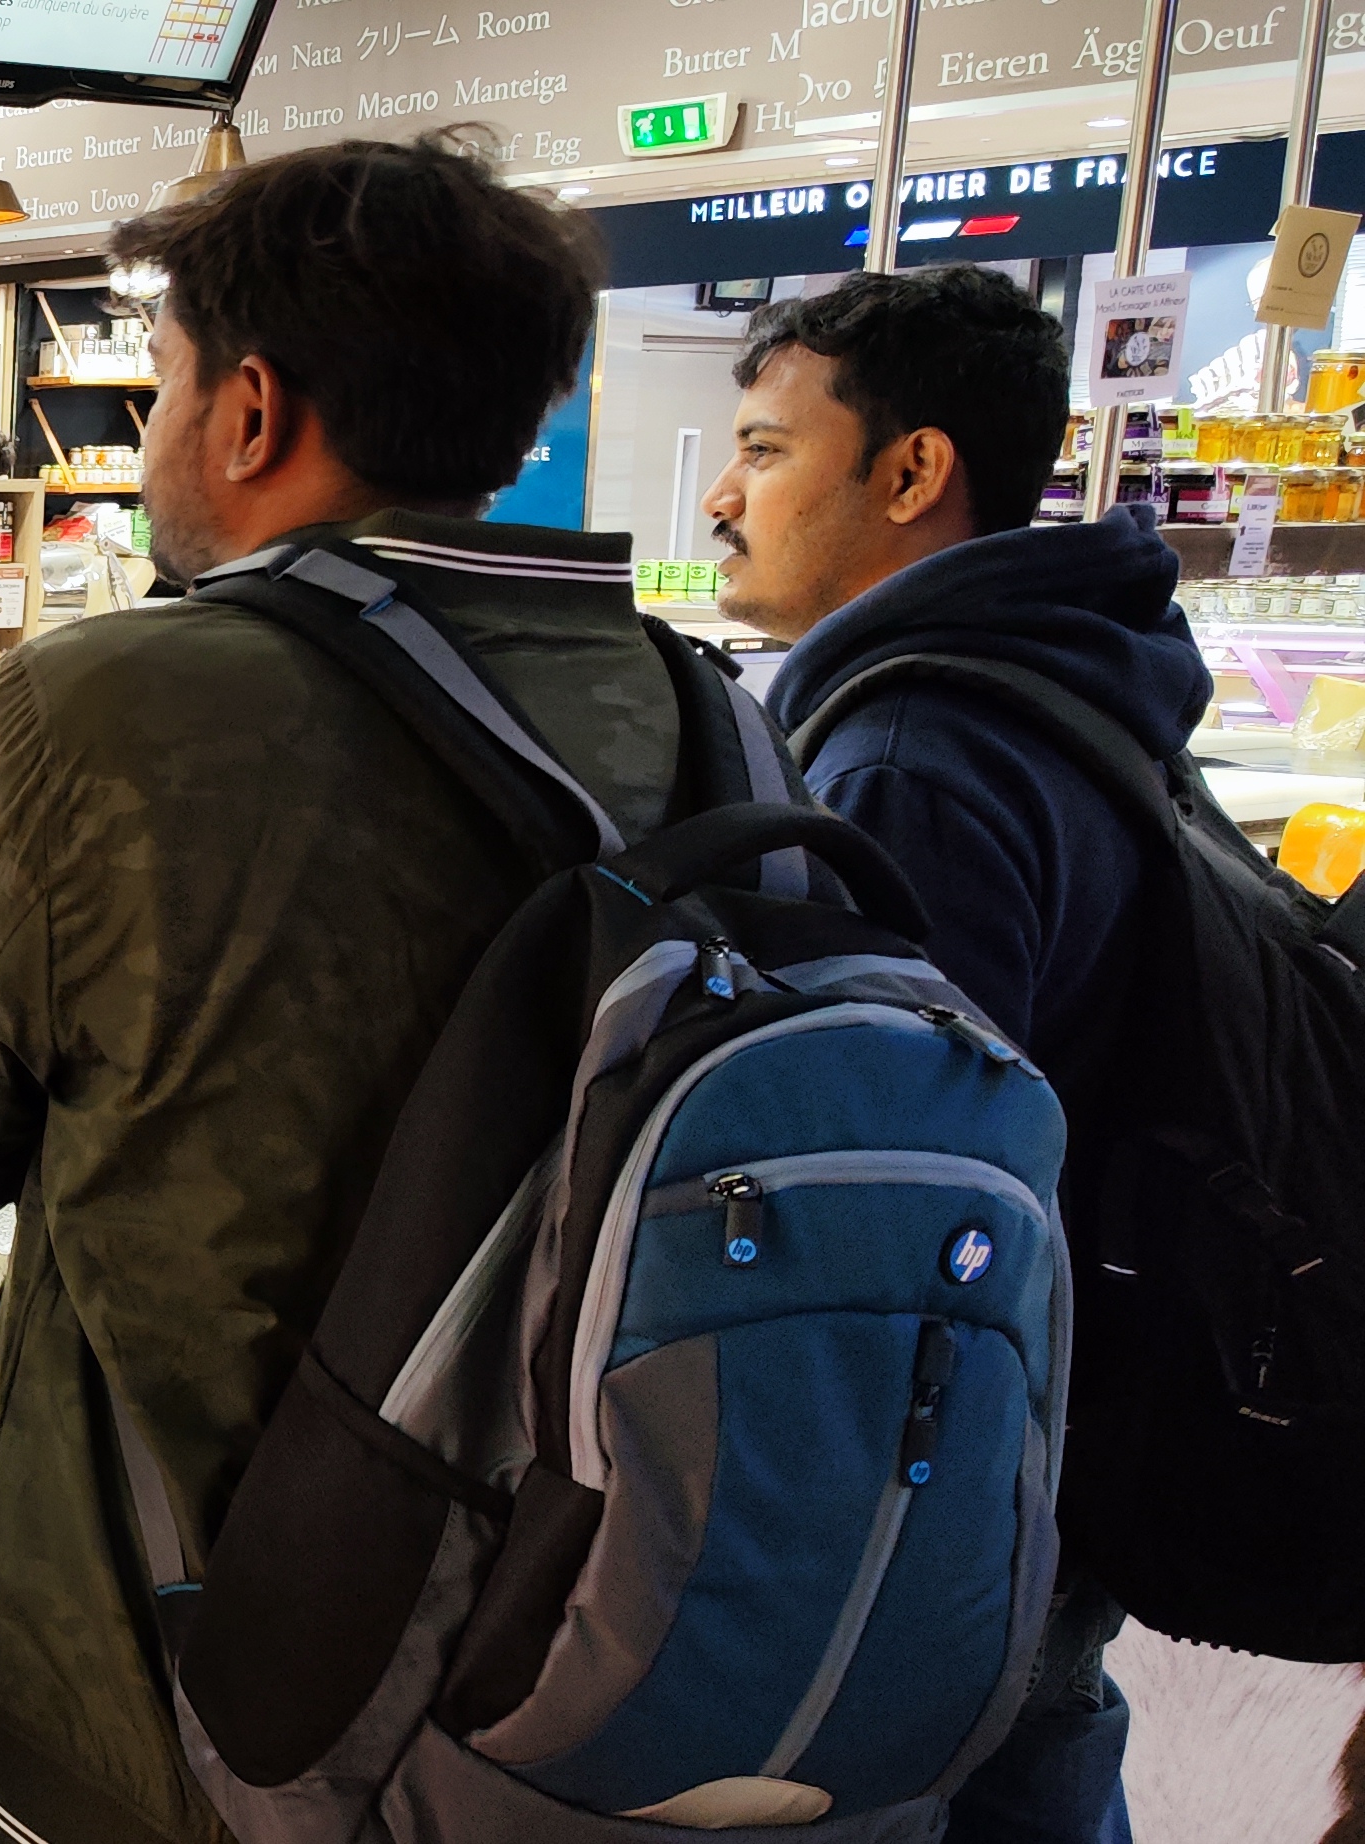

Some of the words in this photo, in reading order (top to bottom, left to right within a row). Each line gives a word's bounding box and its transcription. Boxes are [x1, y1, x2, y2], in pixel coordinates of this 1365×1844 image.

[82, 0, 98, 16] du
[101, 2, 150, 22] Gruyère
[476, 10, 551, 41] Room
[356, 14, 461, 61] クリーム
[937, 51, 1050, 87] Eieren
[1072, 27, 1144, 77] Ägg
[1175, 6, 1286, 56] Oeuf
[291, 42, 342, 71] Nata
[663, 46, 751, 78] Butter
[358, 90, 439, 120] Масло
[452, 70, 568, 107] Manteiga
[15, 145, 73, 170] Beurre
[83, 135, 141, 160] Butter
[283, 105, 344, 131] Burro
[532, 131, 582, 166] Egg
[22, 197, 79, 221] Huevo
[90, 188, 140, 213] Uovo
[690, 186, 826, 223] MEILLEUR
[845, 171, 987, 210] OVRIER
[1009, 163, 1054, 195] DE
[732, 1238, 753, 1262] hp
[955, 1230, 992, 1282] hp
